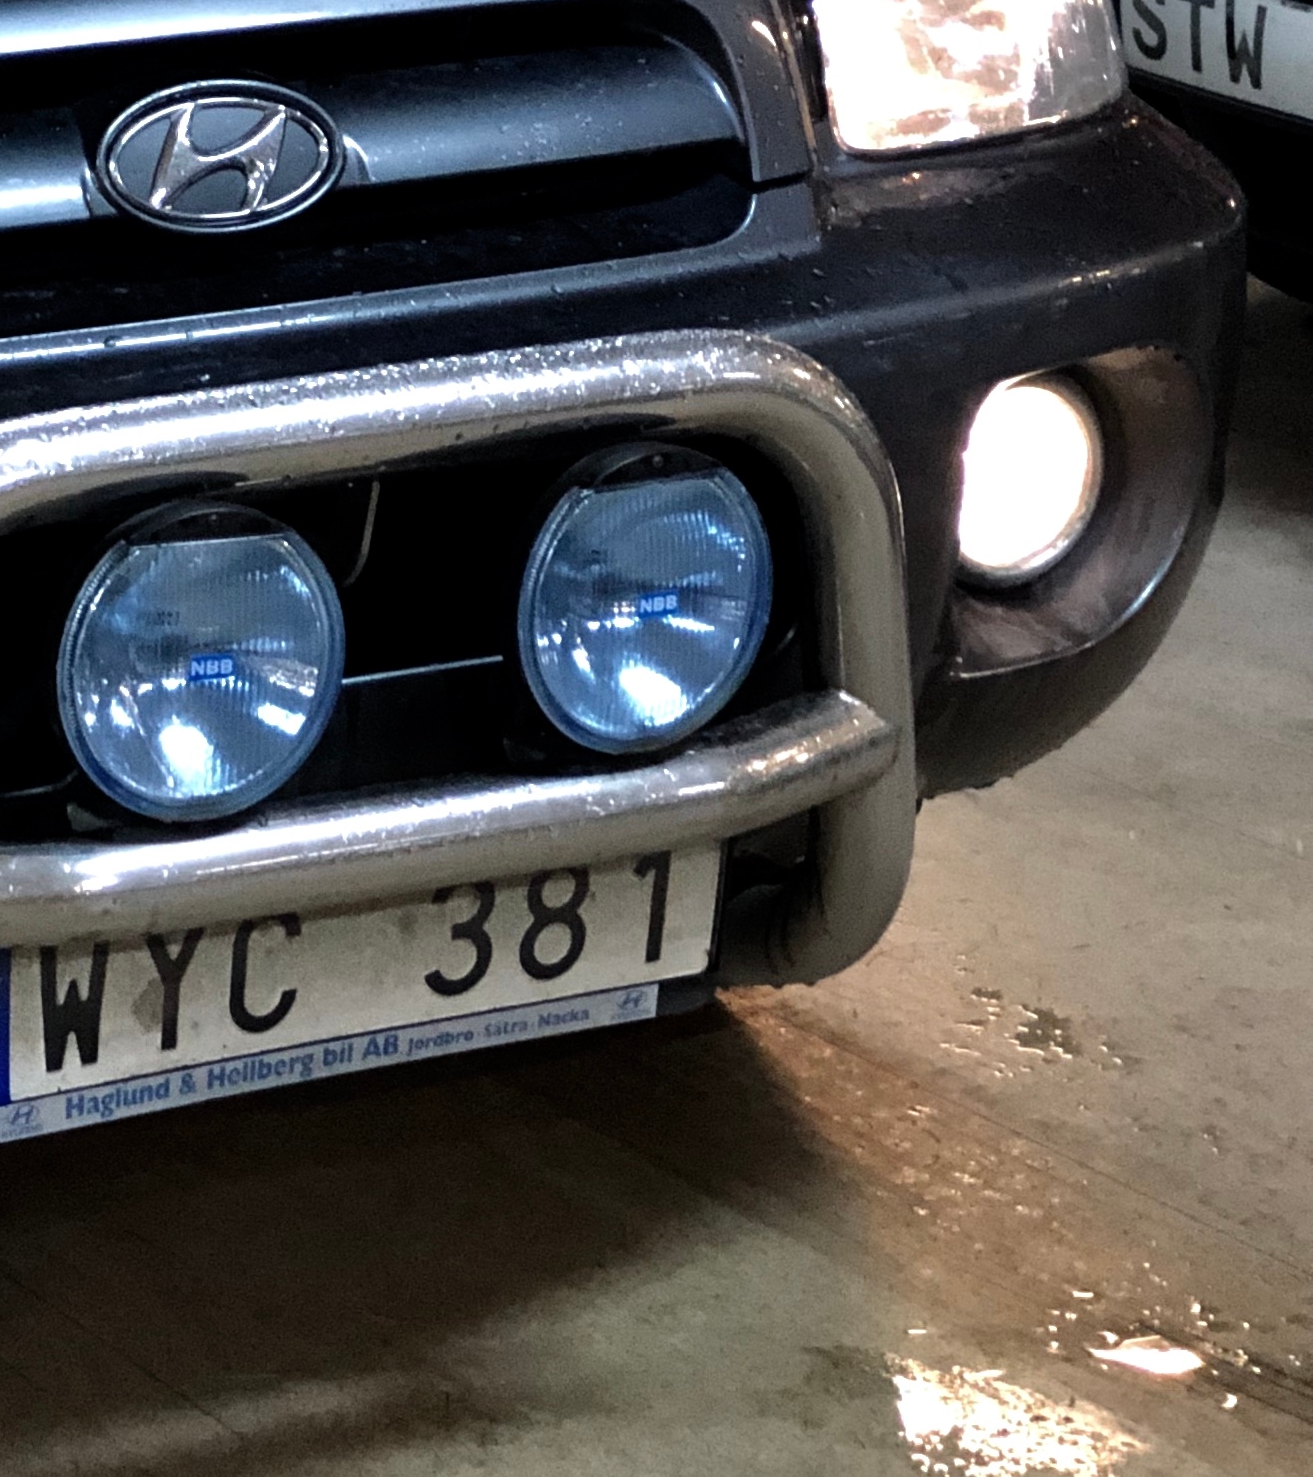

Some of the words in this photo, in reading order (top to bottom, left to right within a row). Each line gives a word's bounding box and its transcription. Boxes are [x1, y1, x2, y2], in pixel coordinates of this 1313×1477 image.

[639, 594, 678, 613] NBB
[190, 658, 233, 676] NBB
[38, 912, 303, 1074] WYC
[423, 851, 672, 998] 381
[64, 1076, 171, 1121] Haglund
[178, 1072, 197, 1096] &
[206, 1048, 315, 1091] Hellberg
[322, 1041, 354, 1068] bil
[360, 1032, 400, 1061] AB
[536, 1006, 590, 1029] Nacka
